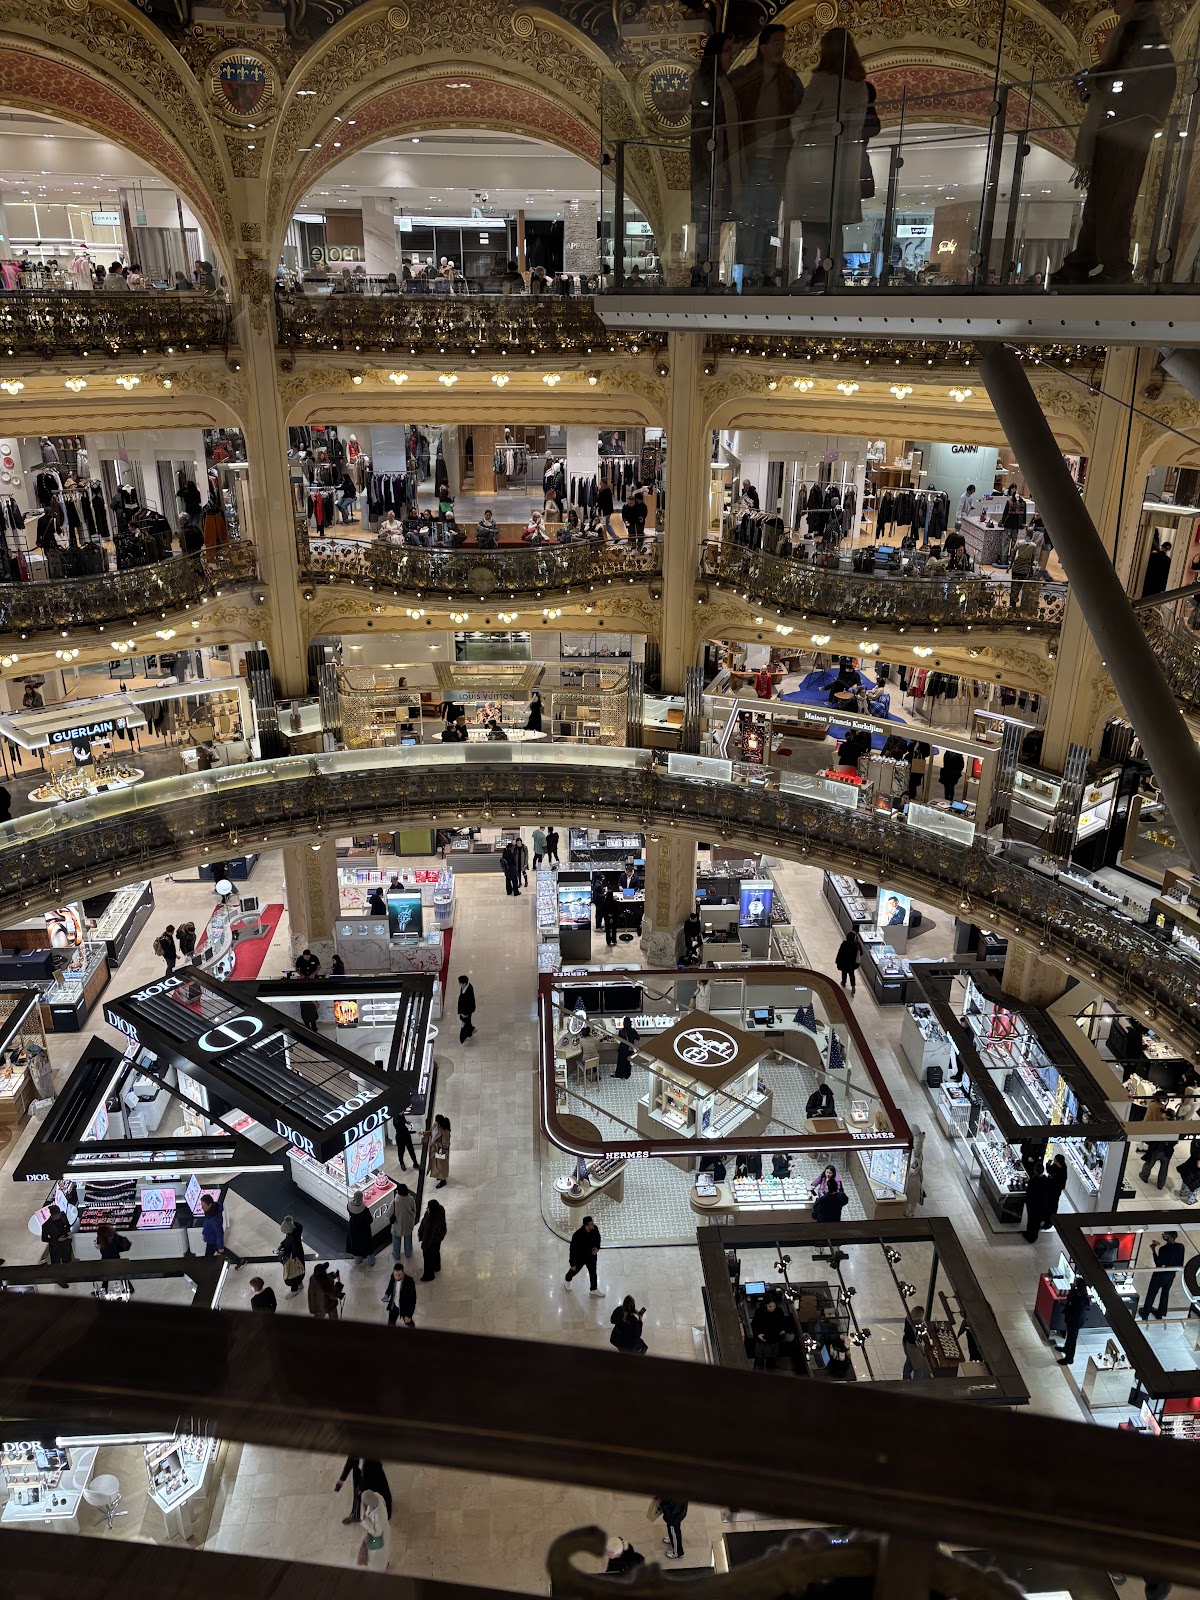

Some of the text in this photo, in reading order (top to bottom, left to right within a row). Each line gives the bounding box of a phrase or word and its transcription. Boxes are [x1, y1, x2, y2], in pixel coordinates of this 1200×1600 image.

[951, 445, 978, 454] GANNI
[53, 721, 113, 742] GUERLAIN
[804, 712, 884, 733] Maison Francis Kurkdjian
[107, 1010, 139, 1042] DIOR
[323, 1090, 378, 1124] DIOR
[343, 1105, 391, 1148] DIOR
[275, 1118, 316, 1158] DIOR
[605, 1151, 649, 1160] HERMÈS
[26, 1173, 50, 1181] DIOR
[2, 1440, 43, 1452] DIOR
